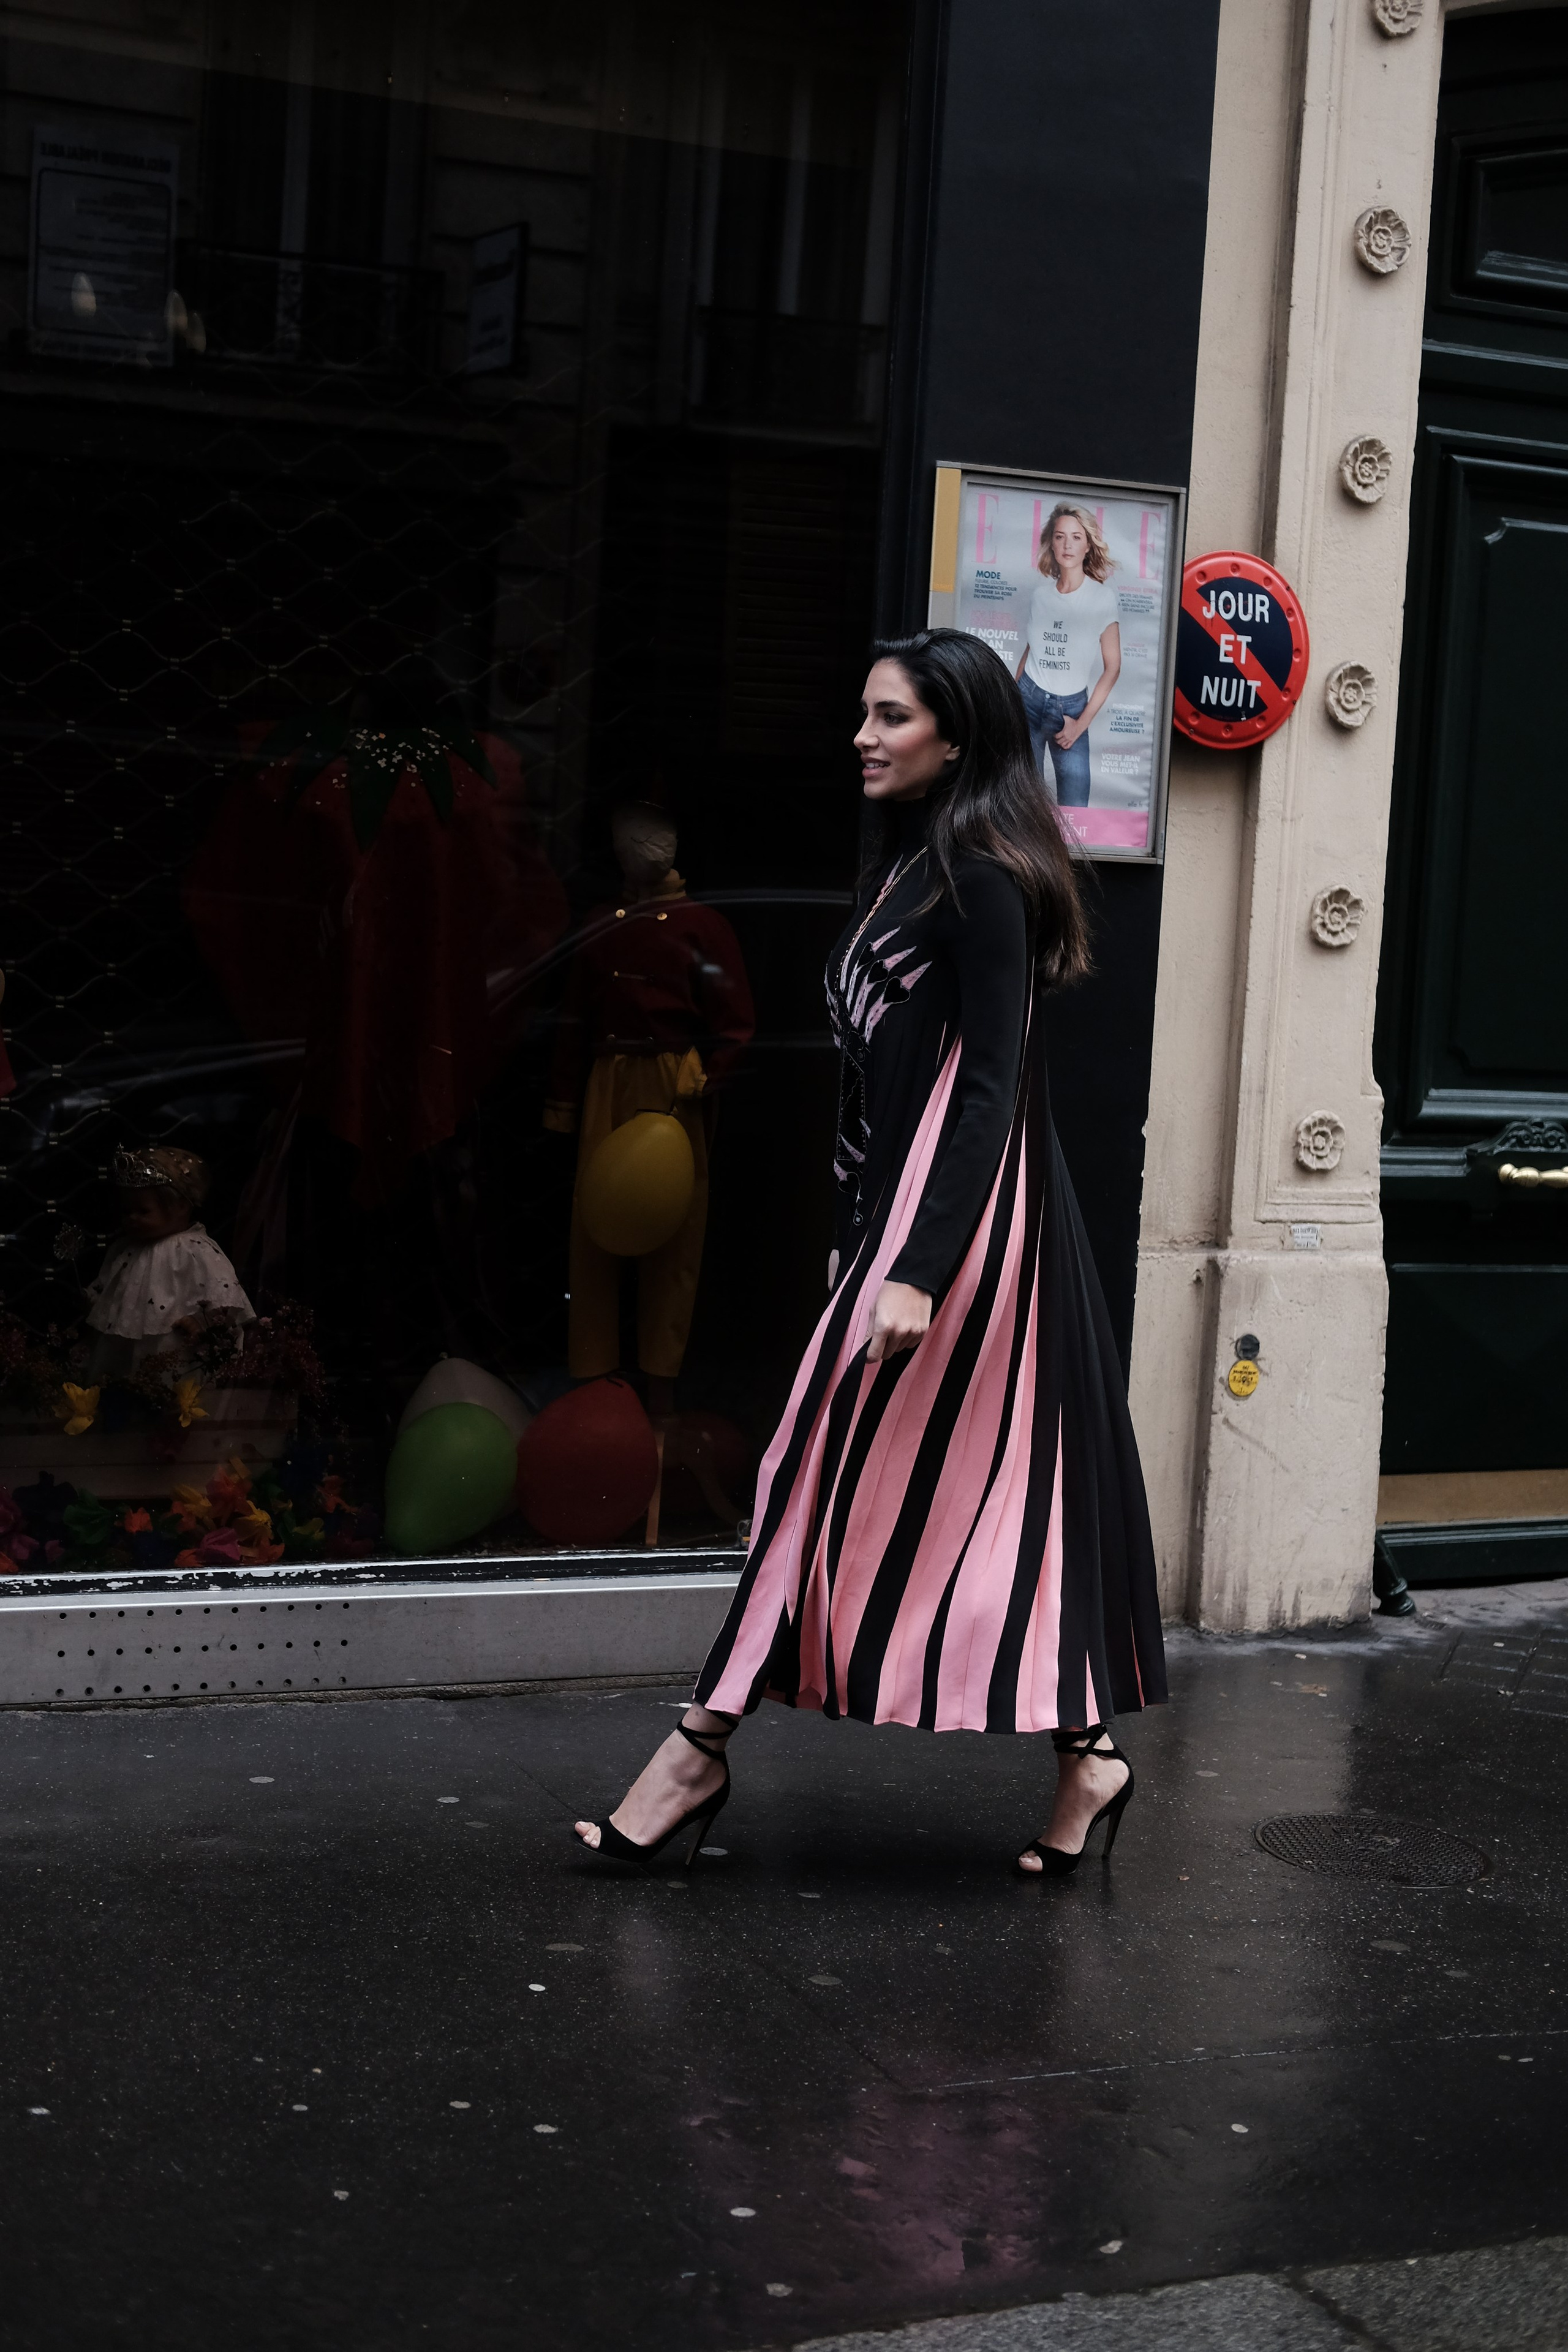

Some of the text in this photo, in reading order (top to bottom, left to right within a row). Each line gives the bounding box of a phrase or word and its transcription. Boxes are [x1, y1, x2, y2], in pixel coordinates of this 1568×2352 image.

[976, 570, 1001, 579] MODE
[1202, 590, 1270, 624] JOUR
[1053, 620, 1063, 629] WE
[978, 627, 1018, 641] NOUVEL
[1042, 631, 1068, 643] SHOULD
[1044, 646, 1066, 657] ALL BE
[1219, 633, 1253, 665] ET
[1039, 658, 1071, 670] FEMINISTS
[1200, 676, 1262, 709] NUIT
